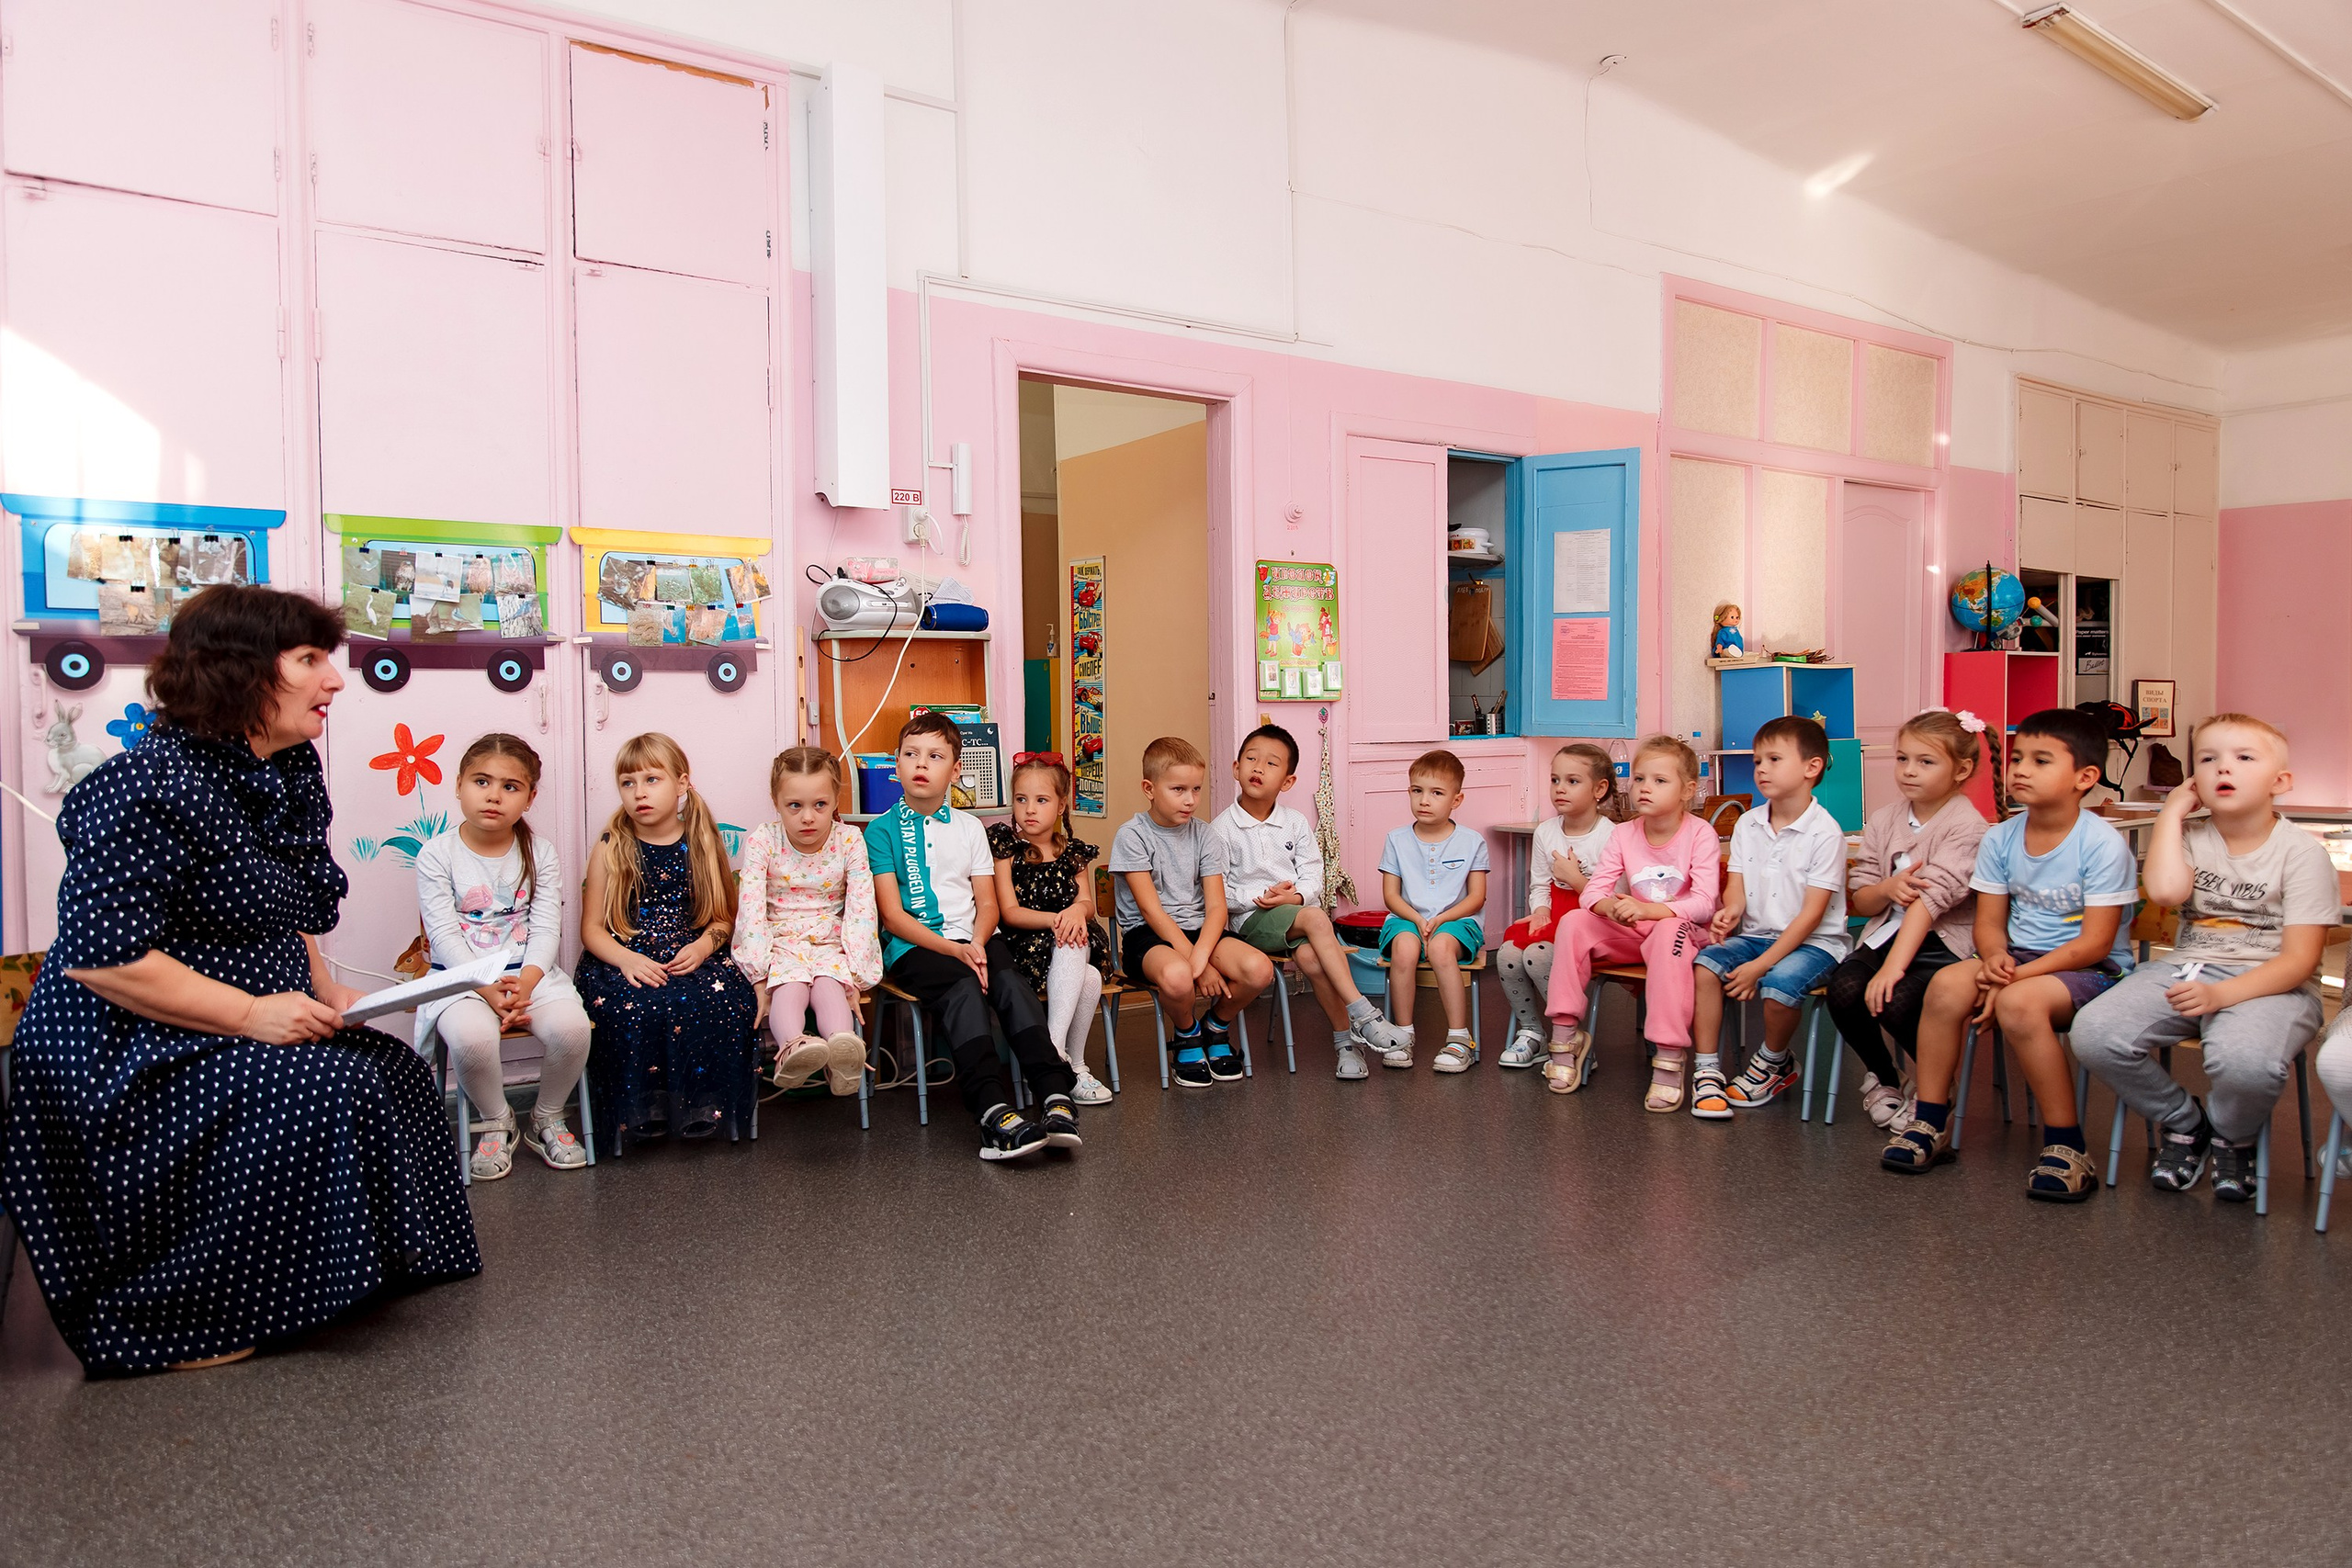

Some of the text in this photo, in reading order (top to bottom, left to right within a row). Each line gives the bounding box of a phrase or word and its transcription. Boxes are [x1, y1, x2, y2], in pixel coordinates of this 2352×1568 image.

[894, 492, 920, 502] 220 В
[1261, 583, 1336, 602] ДЕЖУРСТВ
[899, 819, 917, 845] STAY
[904, 845, 925, 895] PLUGGED
[910, 896, 927, 909] IN
